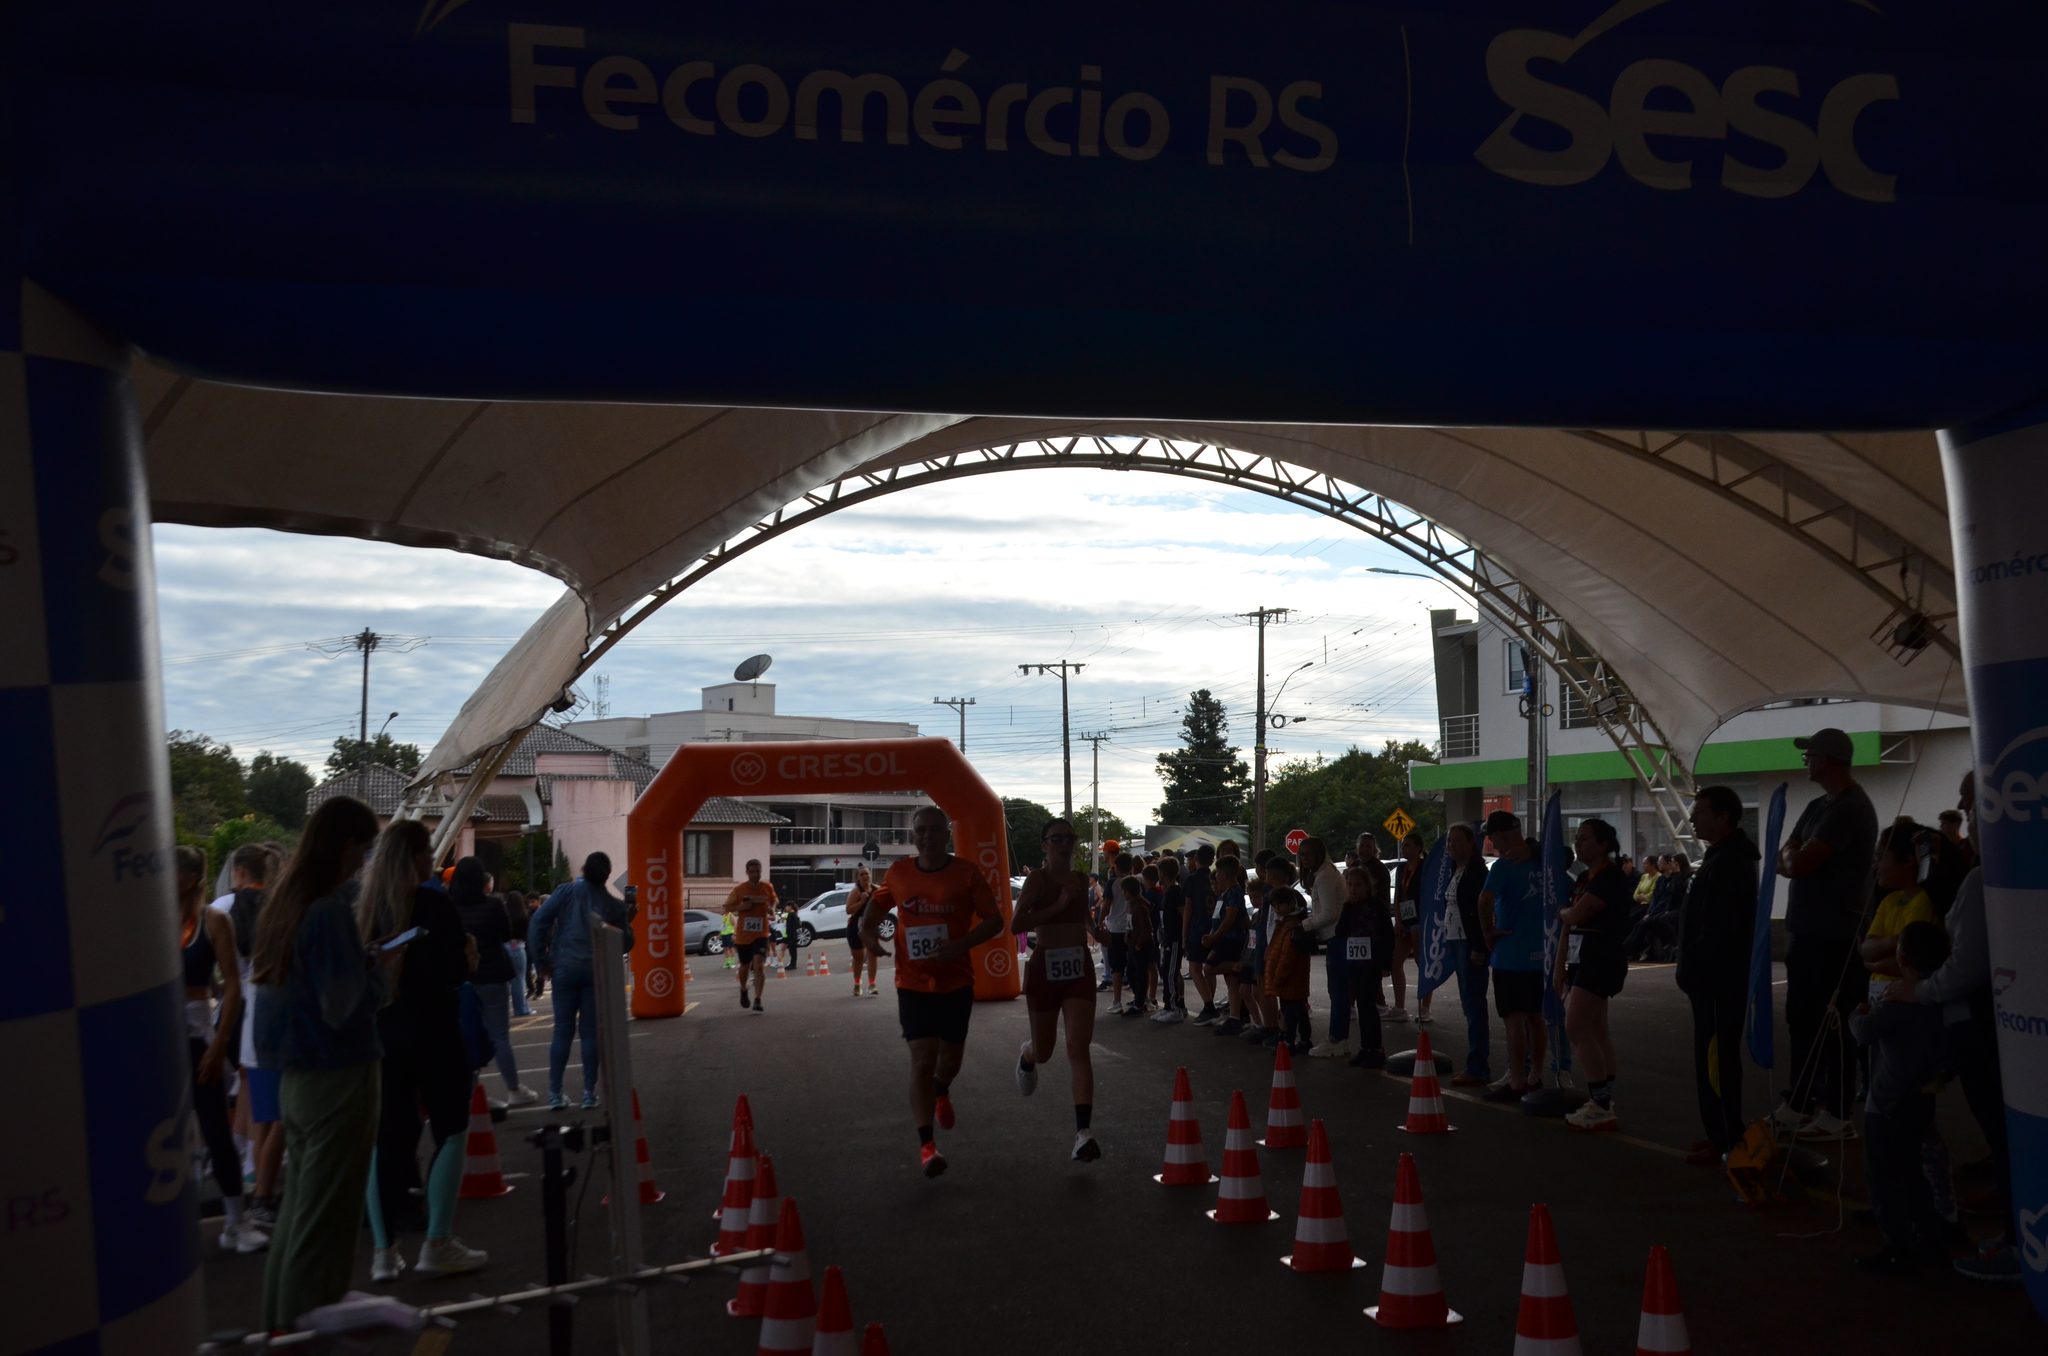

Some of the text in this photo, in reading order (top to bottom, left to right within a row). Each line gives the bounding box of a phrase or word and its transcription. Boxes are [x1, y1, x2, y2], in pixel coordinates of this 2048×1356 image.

[508, 21, 1338, 172] Fecomércio RS
[1473, 27, 1901, 202] Sesc
[777, 752, 907, 780] CRESOL
[646, 848, 669, 958] CRESOL
[911, 937, 944, 958] 58
[1349, 945, 1367, 958] 970
[1051, 959, 1081, 978] 580
